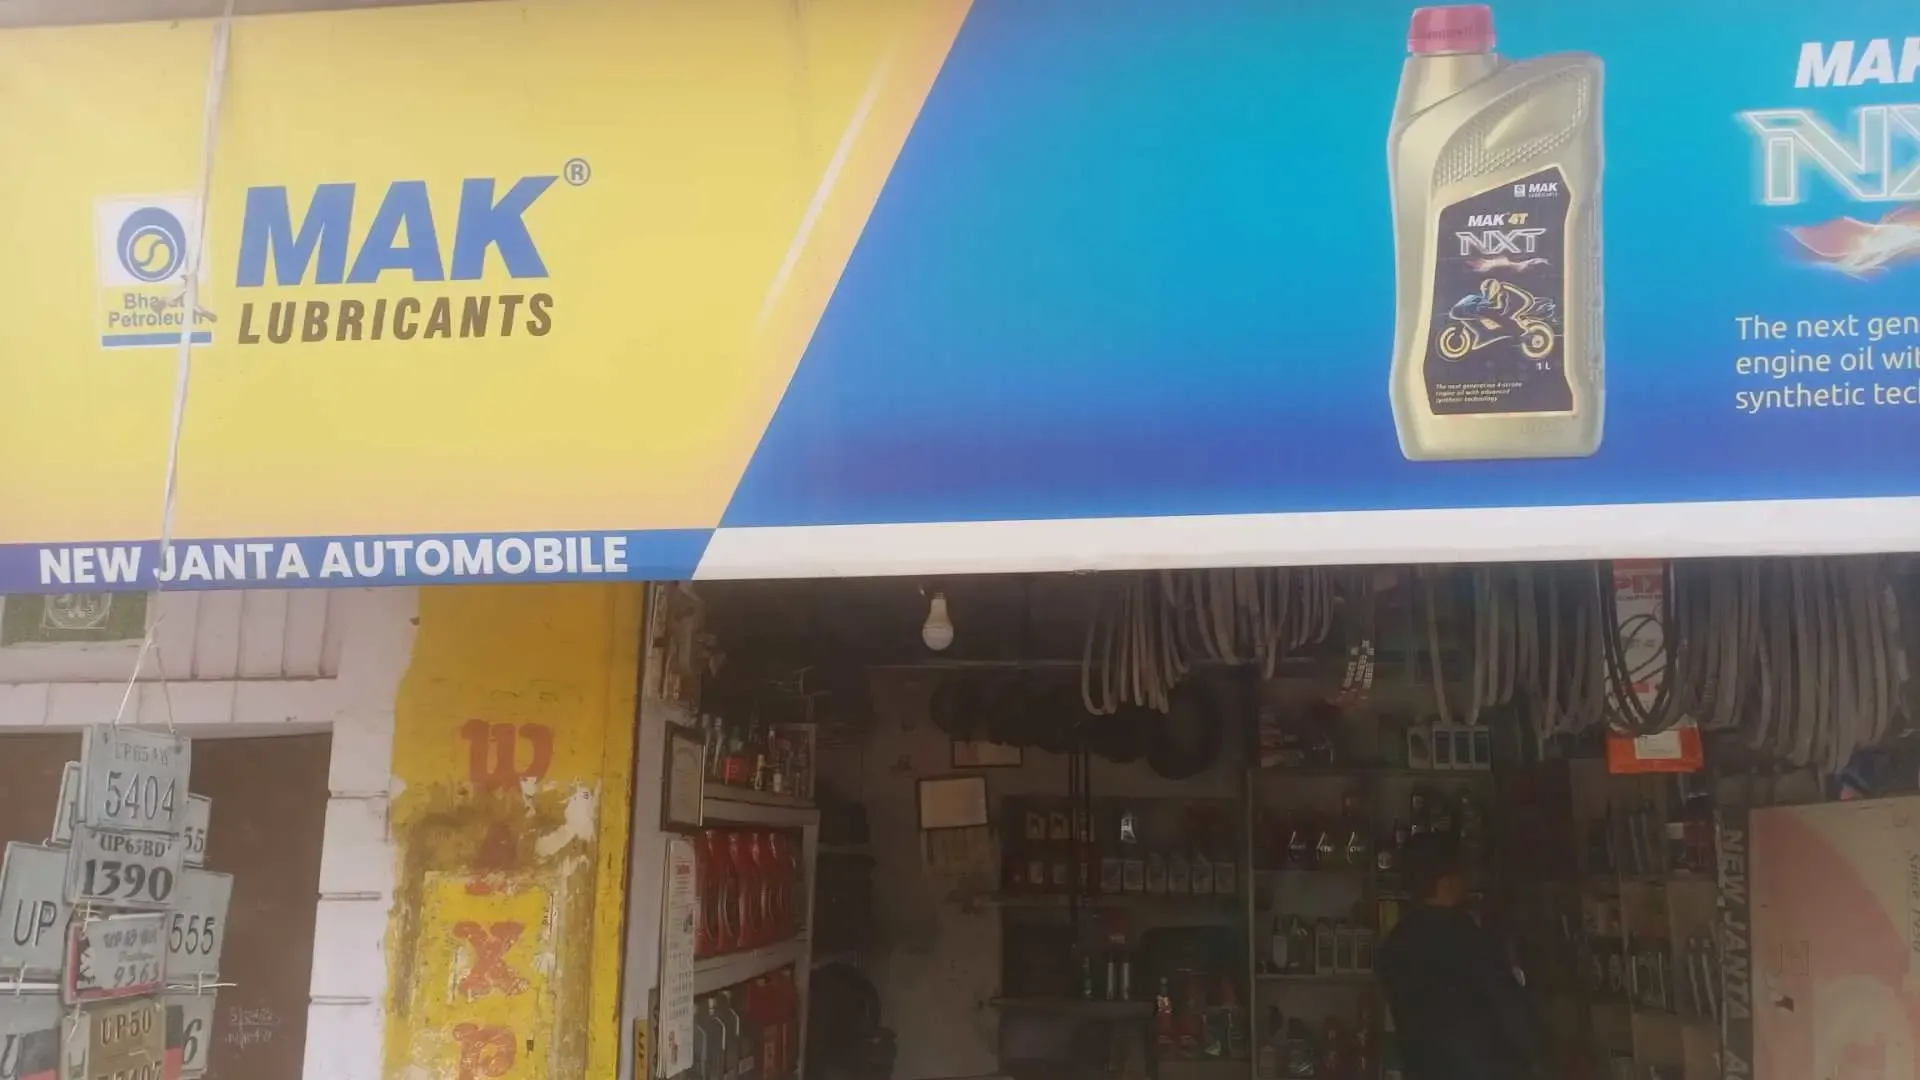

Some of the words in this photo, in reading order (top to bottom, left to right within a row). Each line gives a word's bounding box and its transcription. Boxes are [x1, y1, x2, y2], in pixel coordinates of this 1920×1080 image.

[1529, 182, 1558, 193] MAK
[235, 175, 560, 288] MAK
[1468, 214, 1504, 227] MAK
[1508, 213, 1529, 225] 4T
[1456, 228, 1546, 256] NXT
[238, 293, 553, 345] LUBRICANTS
[1735, 315, 1788, 340] The
[1797, 314, 1860, 338] next
[1736, 349, 1831, 379] engine
[1840, 346, 1874, 371] oil
[1735, 382, 1865, 414] synthetic
[1874, 383, 1920, 405] tec
[39, 547, 141, 584] NEW
[154, 543, 310, 583] JANTA
[320, 537, 628, 577] AUTOMOBILE
[105, 769, 176, 821] 5404
[82, 859, 173, 902] 1390
[1721, 829, 1747, 905] NEW
[13, 899, 57, 947] UP
[169, 914, 215, 955] 555
[1723, 911, 1751, 1020] JANTA
[102, 1007, 151, 1047] UP50
